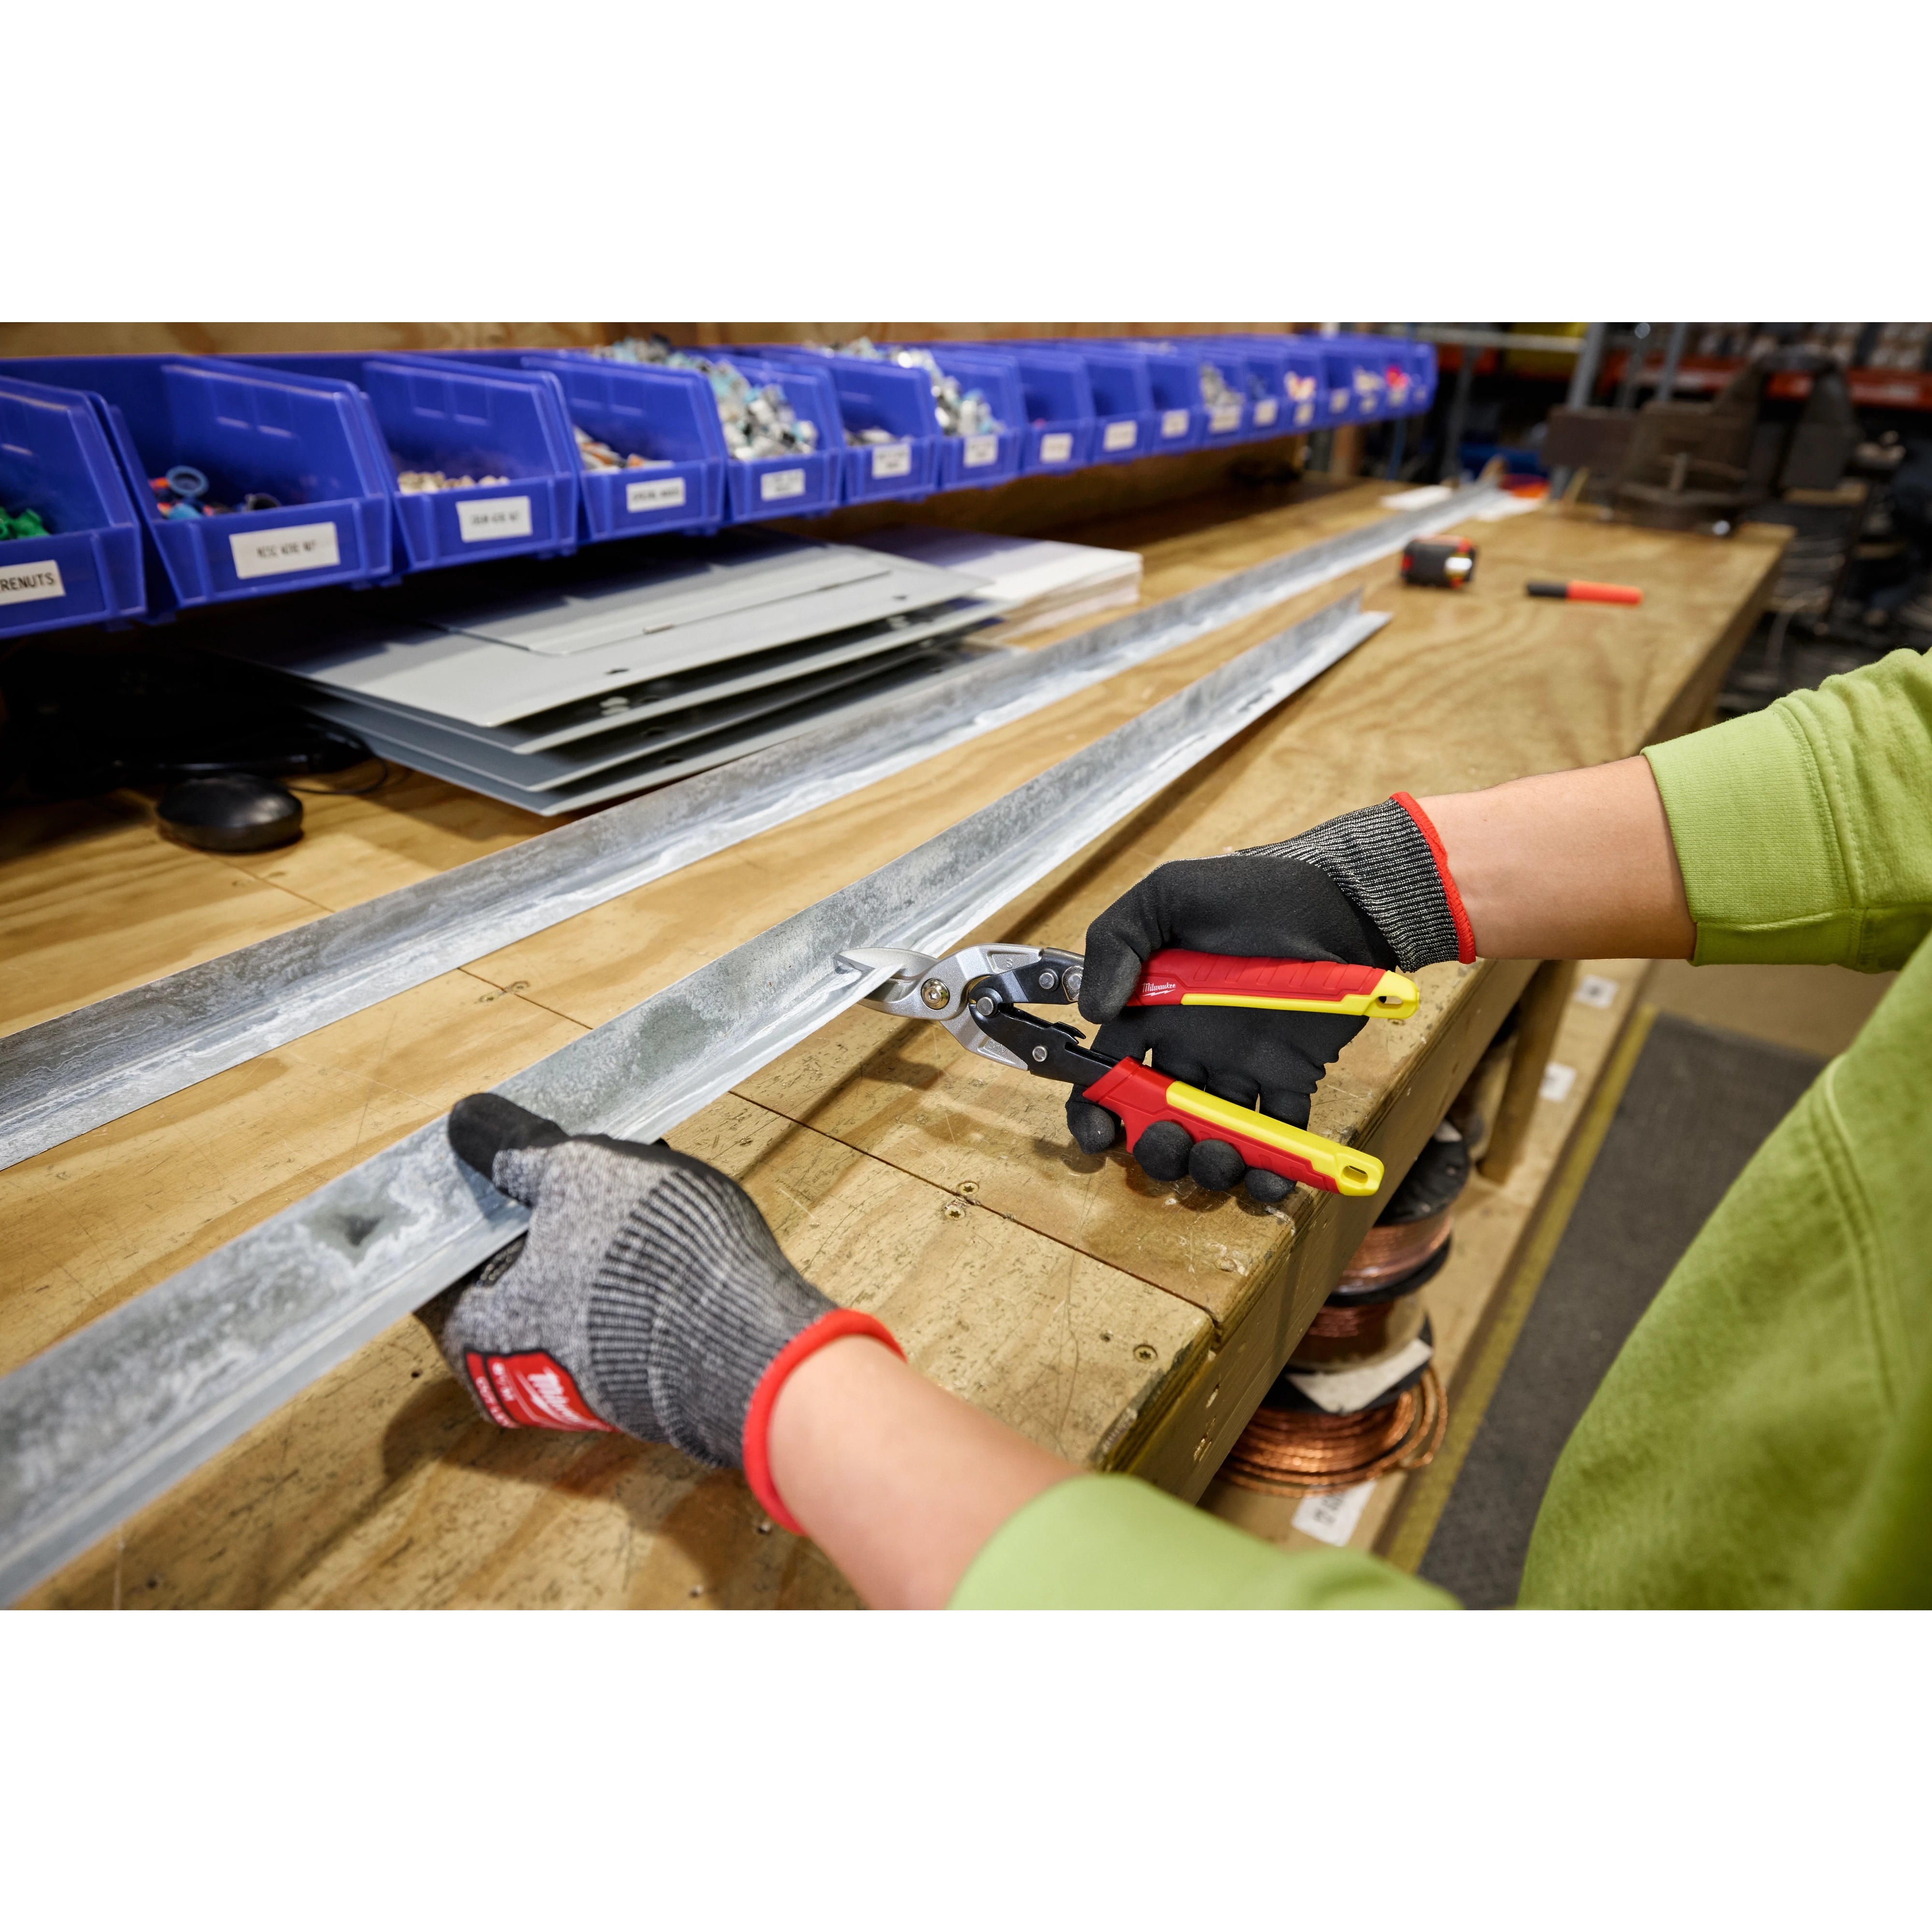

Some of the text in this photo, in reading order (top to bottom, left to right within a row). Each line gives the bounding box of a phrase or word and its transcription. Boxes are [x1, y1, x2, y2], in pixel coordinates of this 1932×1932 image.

[0, 572, 55, 591] RENUTS
[1006, 958, 1013, 969] S
[1142, 982, 1176, 993] Milwaukee
